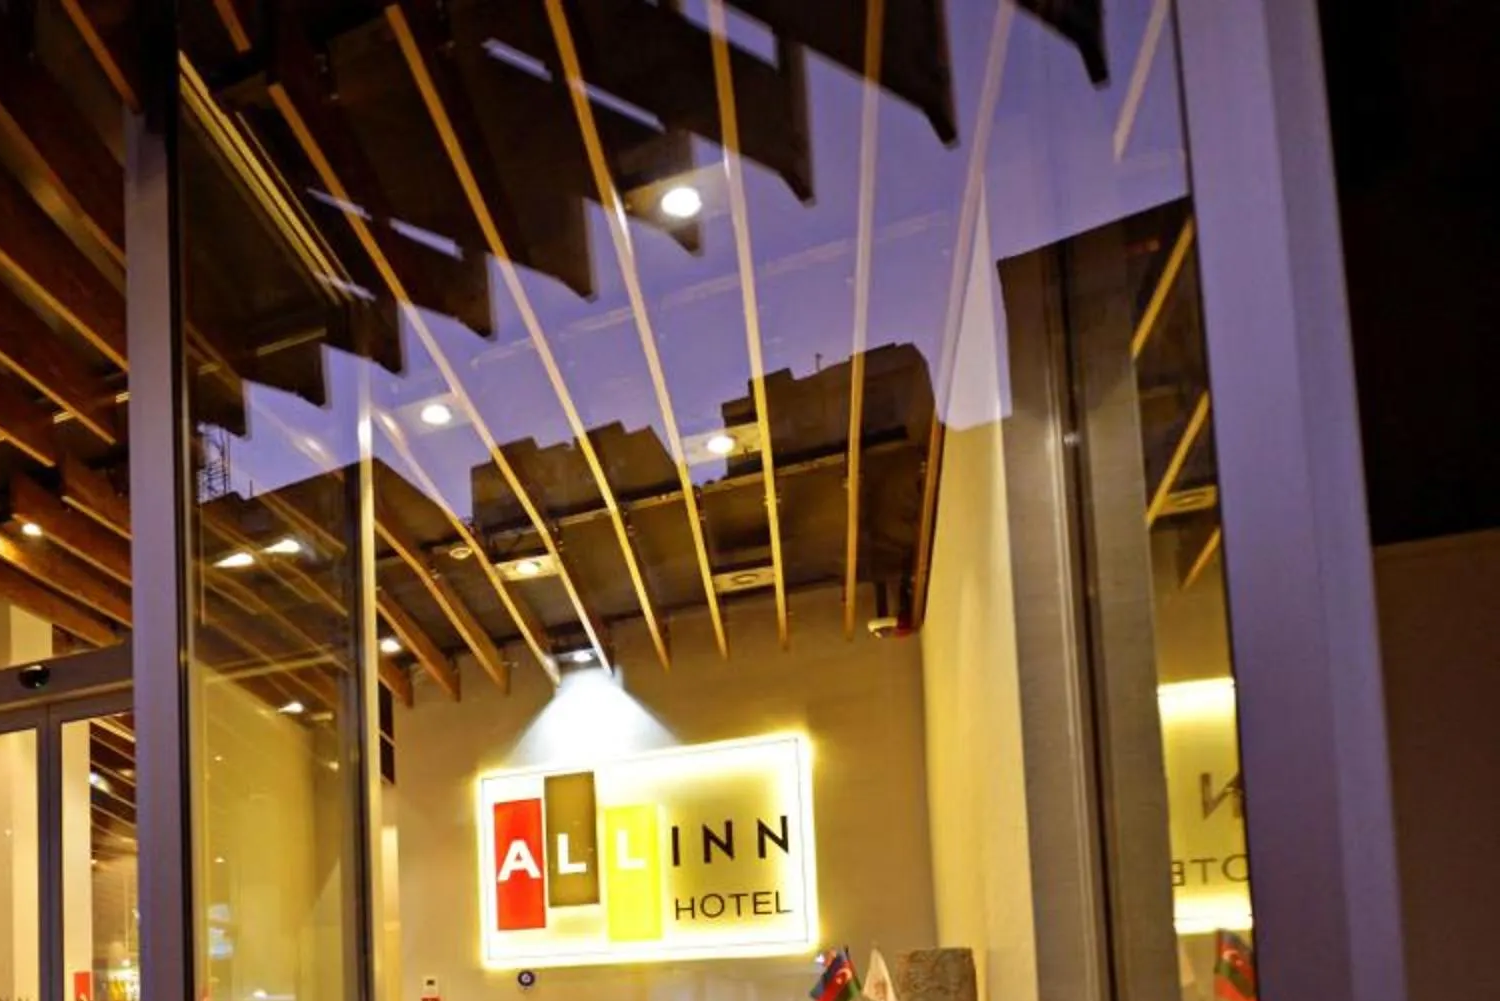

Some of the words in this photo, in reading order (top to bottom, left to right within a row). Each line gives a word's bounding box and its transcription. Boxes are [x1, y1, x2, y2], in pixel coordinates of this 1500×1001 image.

[497, 829, 647, 882] ALL
[671, 815, 790, 866] INN
[675, 891, 793, 921] HOTEL
